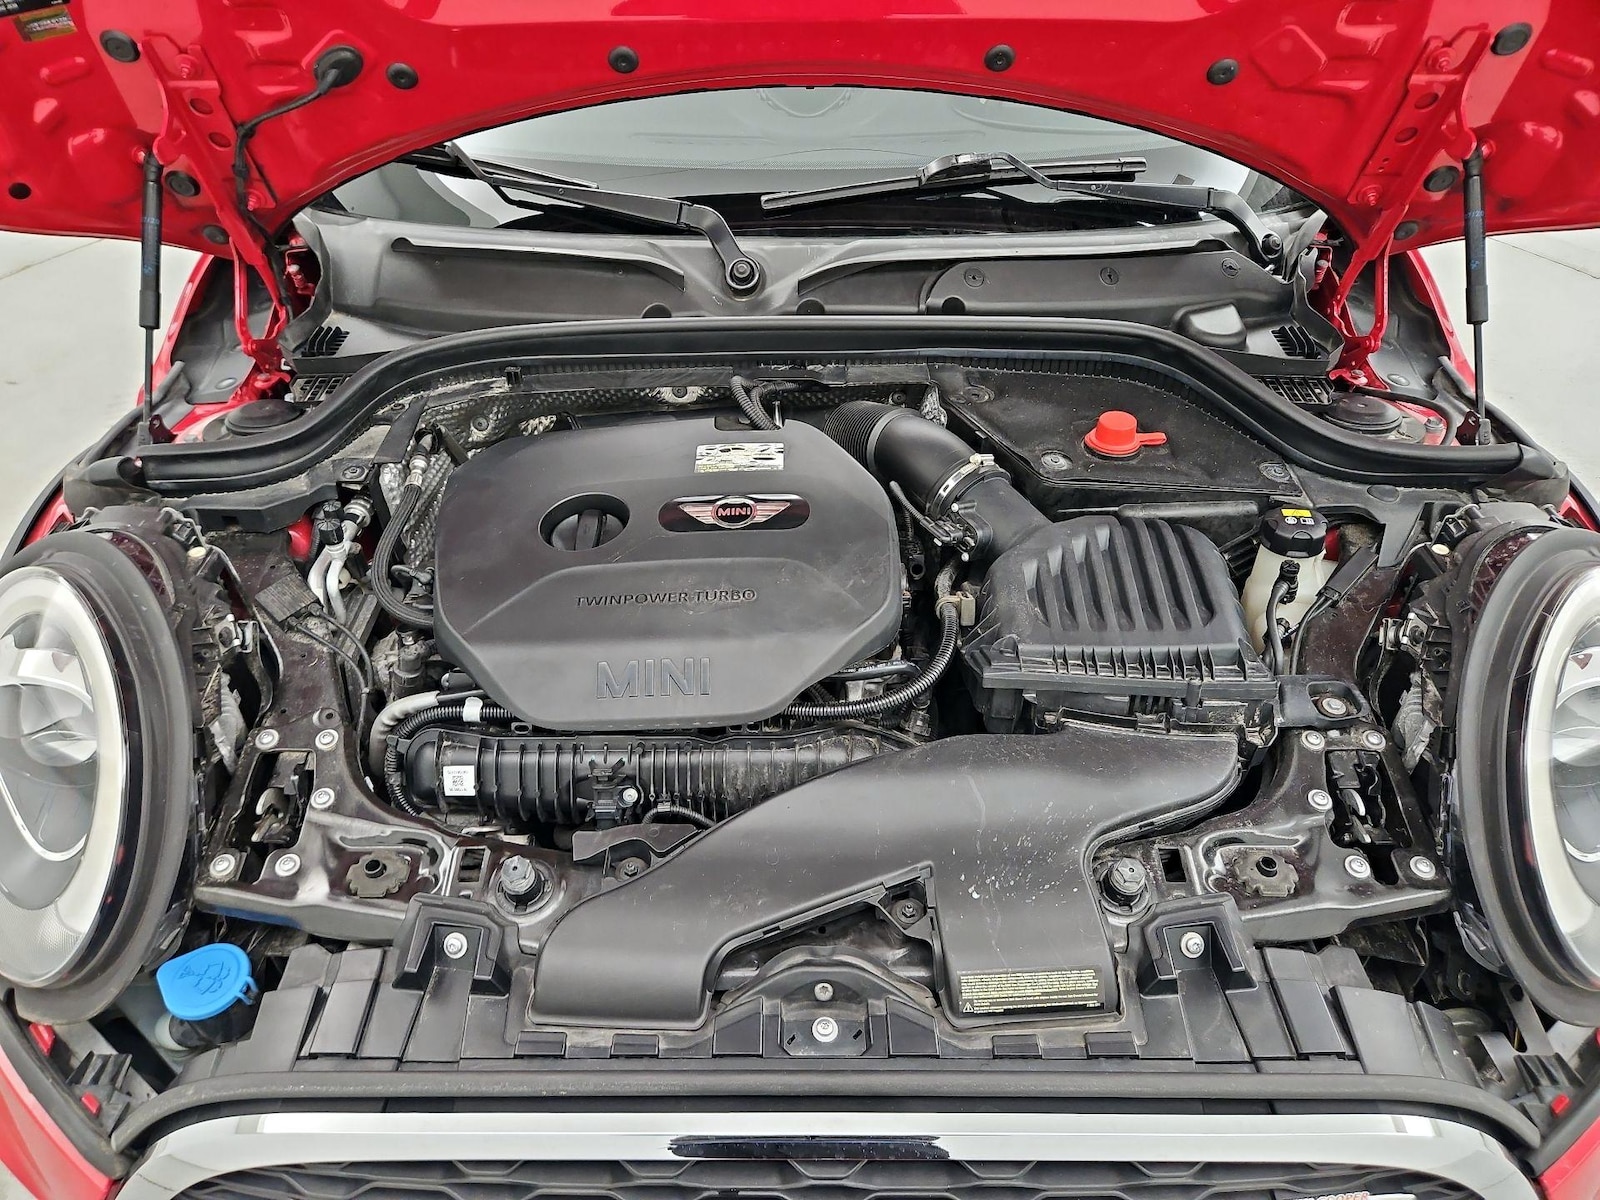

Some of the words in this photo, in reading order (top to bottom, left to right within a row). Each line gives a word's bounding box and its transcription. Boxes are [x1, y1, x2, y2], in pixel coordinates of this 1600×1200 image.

[717, 507, 751, 517] MINI
[576, 592, 688, 607] TWINPOWER
[695, 588, 756, 602] TURBO
[597, 657, 711, 699] MINI
